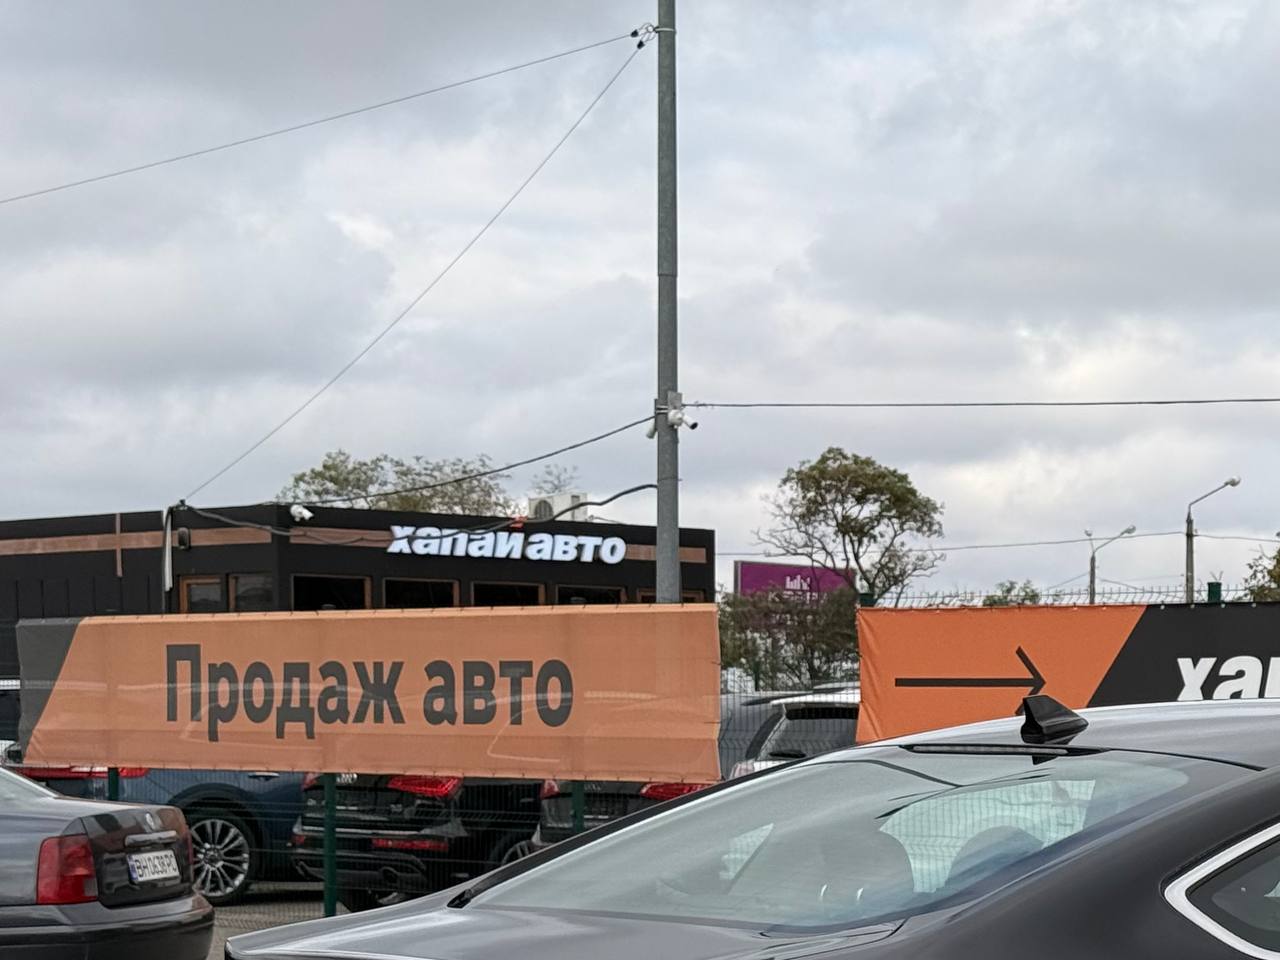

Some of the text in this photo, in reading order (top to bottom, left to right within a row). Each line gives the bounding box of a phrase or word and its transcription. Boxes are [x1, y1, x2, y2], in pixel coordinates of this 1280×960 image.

[526, 533, 627, 565] авто
[166, 643, 574, 742] Продаж авто
